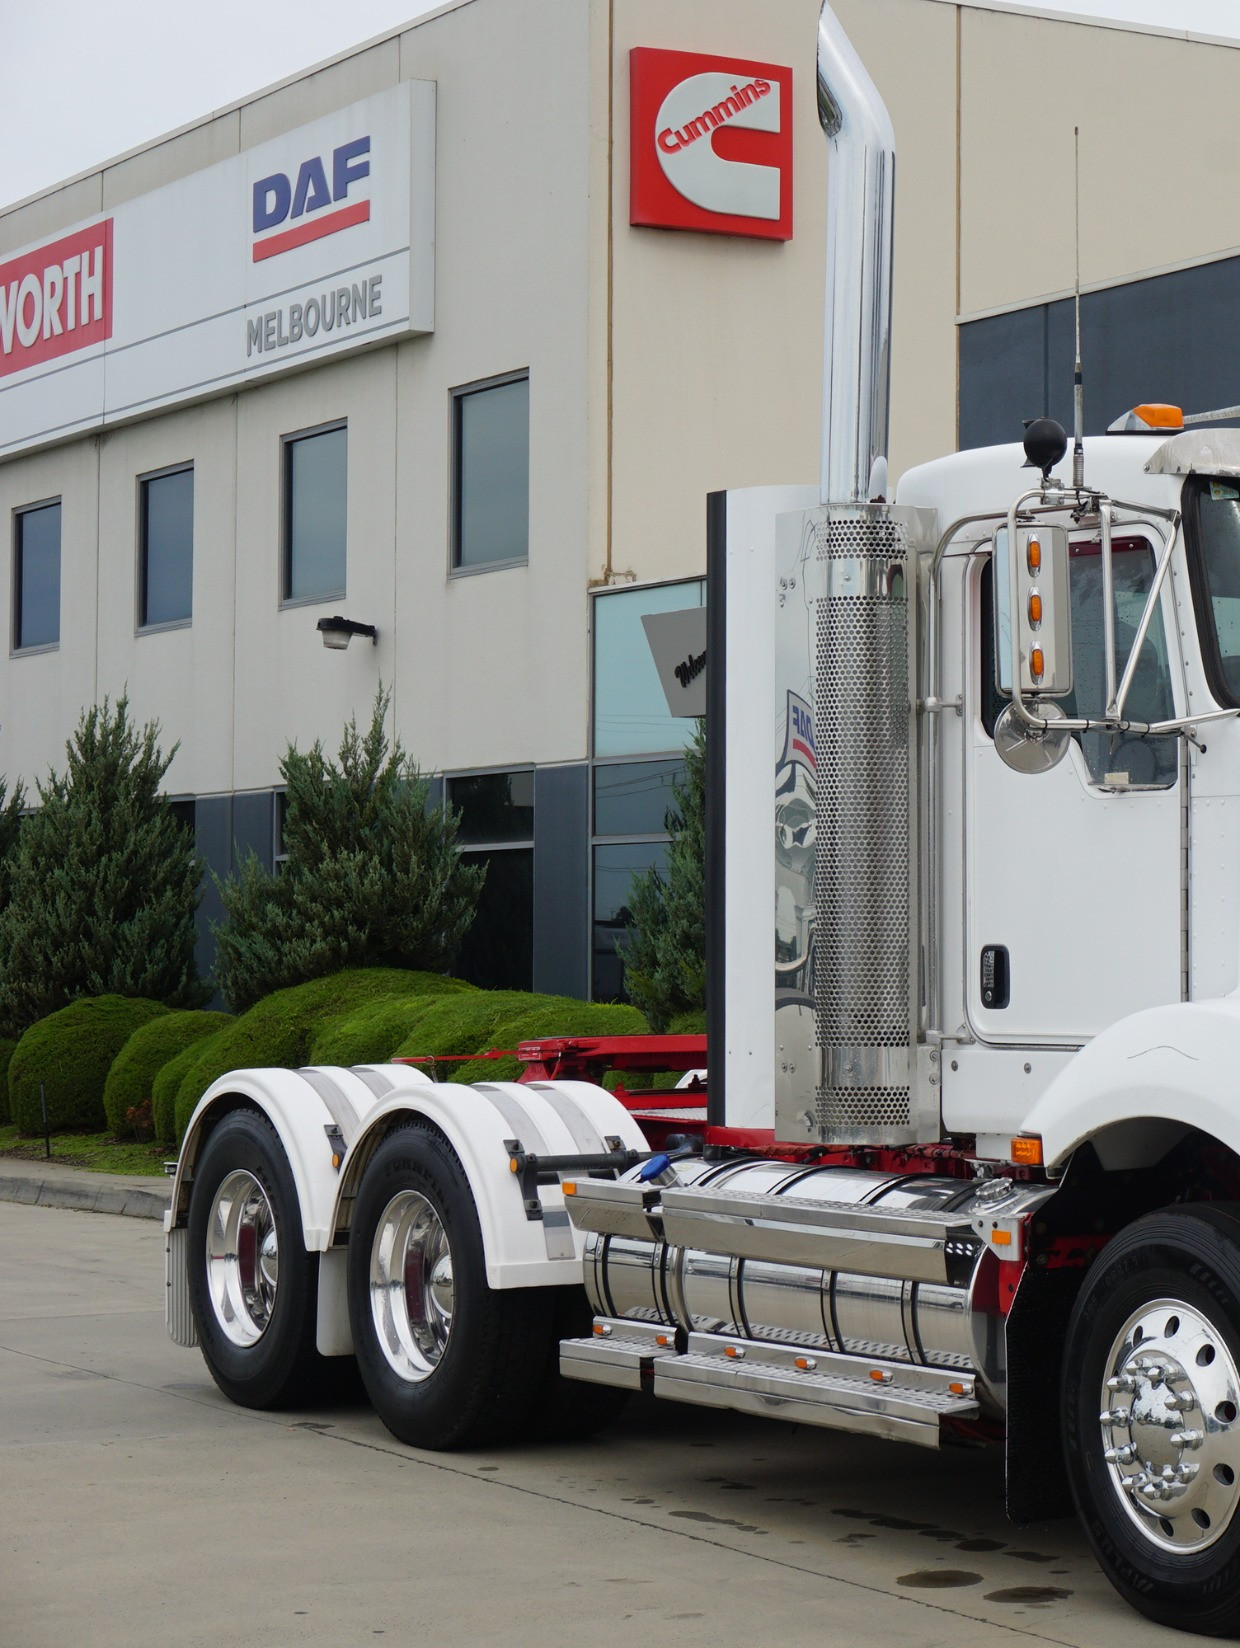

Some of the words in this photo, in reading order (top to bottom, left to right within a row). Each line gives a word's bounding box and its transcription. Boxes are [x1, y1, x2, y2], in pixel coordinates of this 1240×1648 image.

[657, 79, 771, 154] Cummins
[253, 135, 370, 233] DAF
[247, 274, 382, 357] MELBOURNE
